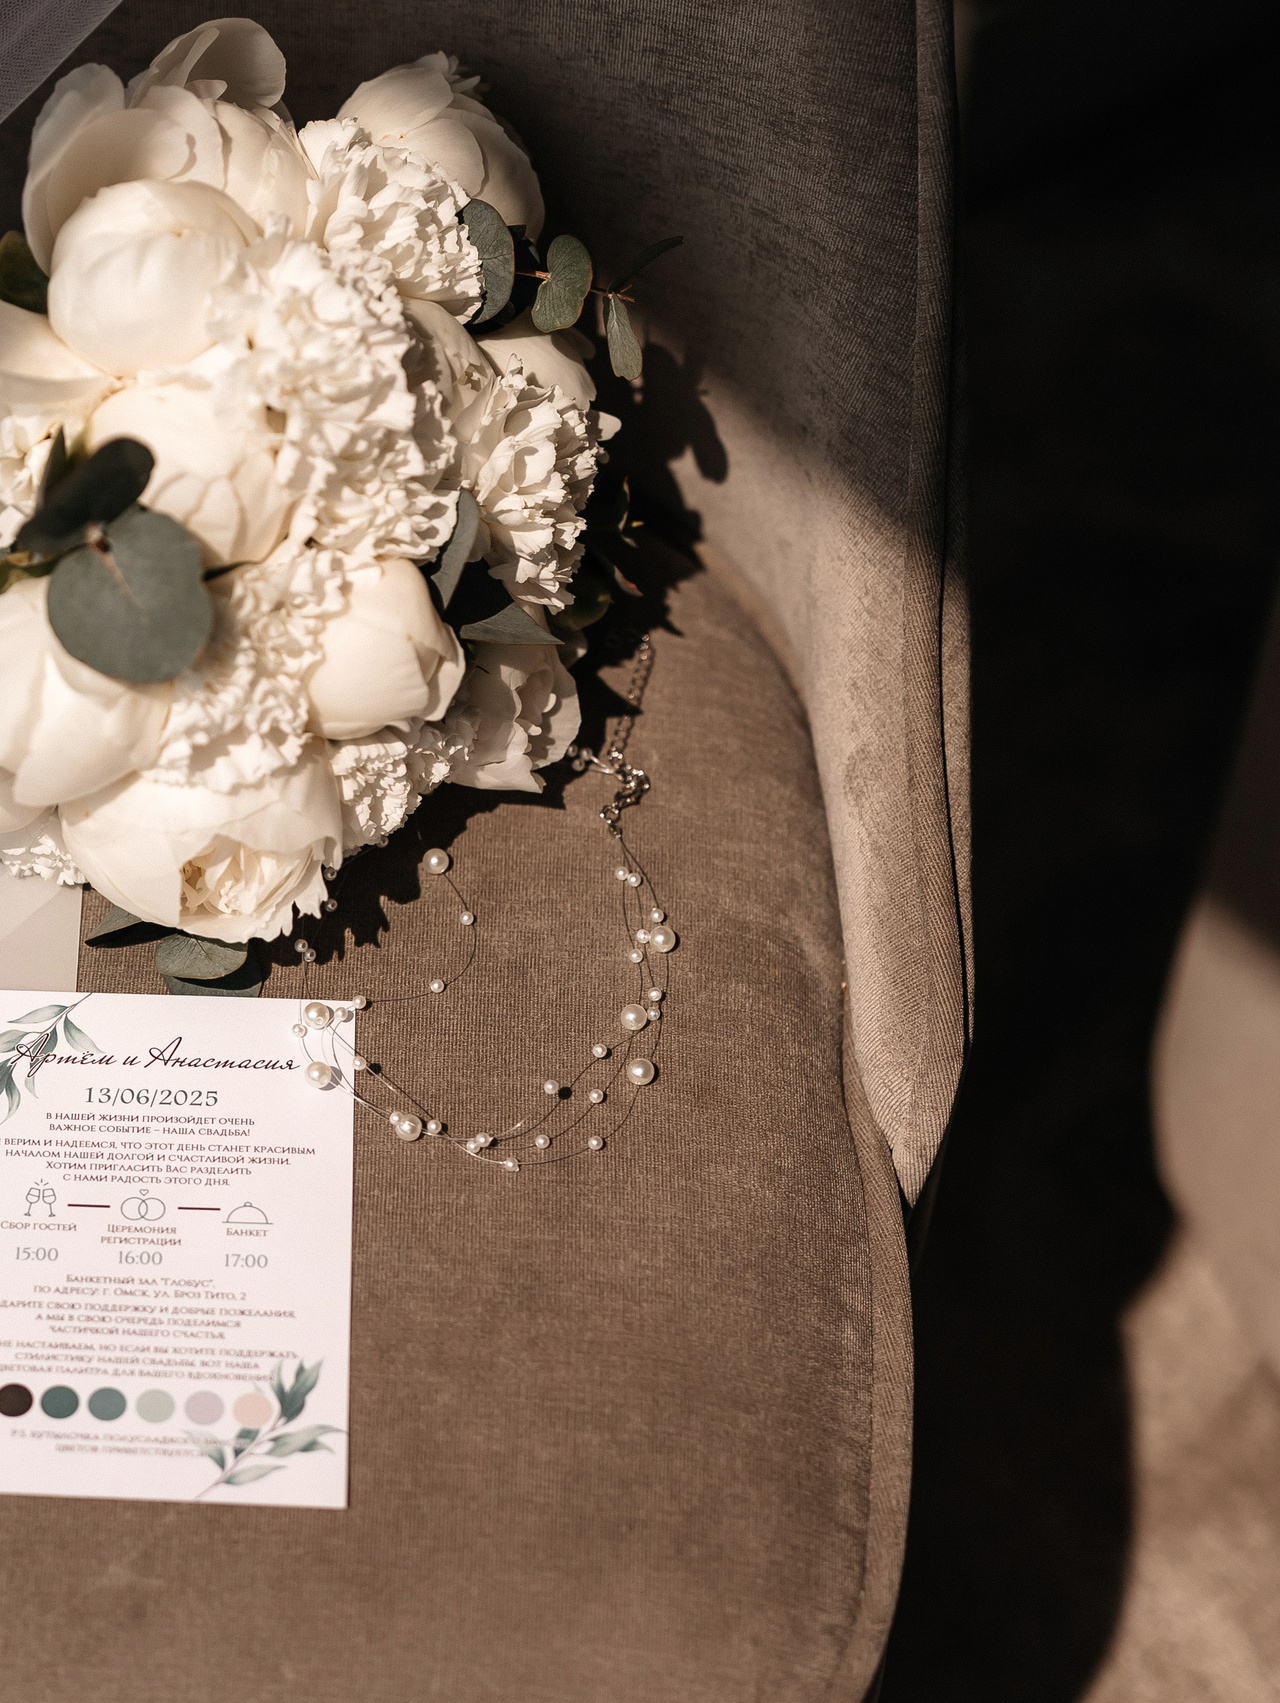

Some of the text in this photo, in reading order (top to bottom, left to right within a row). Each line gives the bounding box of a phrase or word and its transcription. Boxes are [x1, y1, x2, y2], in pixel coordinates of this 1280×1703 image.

[11, 1033, 301, 1077] Артём и Анастасия
[85, 1085, 219, 1108] 13/06/2025
[55, 1112, 95, 1121] НАШЕЙ
[98, 1113, 139, 1122] ЖИЗНИ
[142, 1115, 216, 1125] ПРОИЗОЙДЕТ
[218, 1117, 254, 1125] ОЧЕНЬ
[49, 1123, 96, 1132] ВАЖНОЕ
[98, 1124, 151, 1133] СОБЫТИЕ
[162, 1126, 195, 1135] НАША
[198, 1127, 250, 1137] СВАДЬБА!
[4, 1137, 40, 1146] ВЕРИМ
[120, 1141, 142, 1149] ЧТО
[144, 1142, 174, 1150] ЭТОТ
[176, 1143, 205, 1152] ДЕНЬ
[207, 1144, 251, 1152] СТАНЕТ
[253, 1145, 315, 1154] КРАСИВЫМ
[5, 1148, 60, 1158] НАЧАЛОМ
[63, 1150, 104, 1159] НАШЕЙ
[106, 1152, 154, 1161] ДОЛГОЙ
[156, 1153, 165, 1161] И
[167, 1154, 244, 1163] СЧАСТЛИВОЙ
[45, 1160, 251, 1175] ХОТИМ ПРИГЛАСИТЬ ВАС РАЗДЕЛИТЬ
[62, 1173, 71, 1181] С
[73, 1173, 107, 1182] НАМИ
[110, 1174, 161, 1184] РАДОСТЬ
[163, 1176, 202, 1185] ЭТОГО
[0, 1220, 76, 1231] СБОР ГОСТЕЙ
[106, 1223, 176, 1234] ЦЕРЕМОНИЯ
[226, 1227, 268, 1237] БАНКЕТ
[100, 1235, 181, 1246] РЕГИСТРАЦИИ
[15, 1246, 58, 1261] 15:00
[118, 1250, 163, 1265] 16:00
[224, 1253, 268, 1268] 17:00
